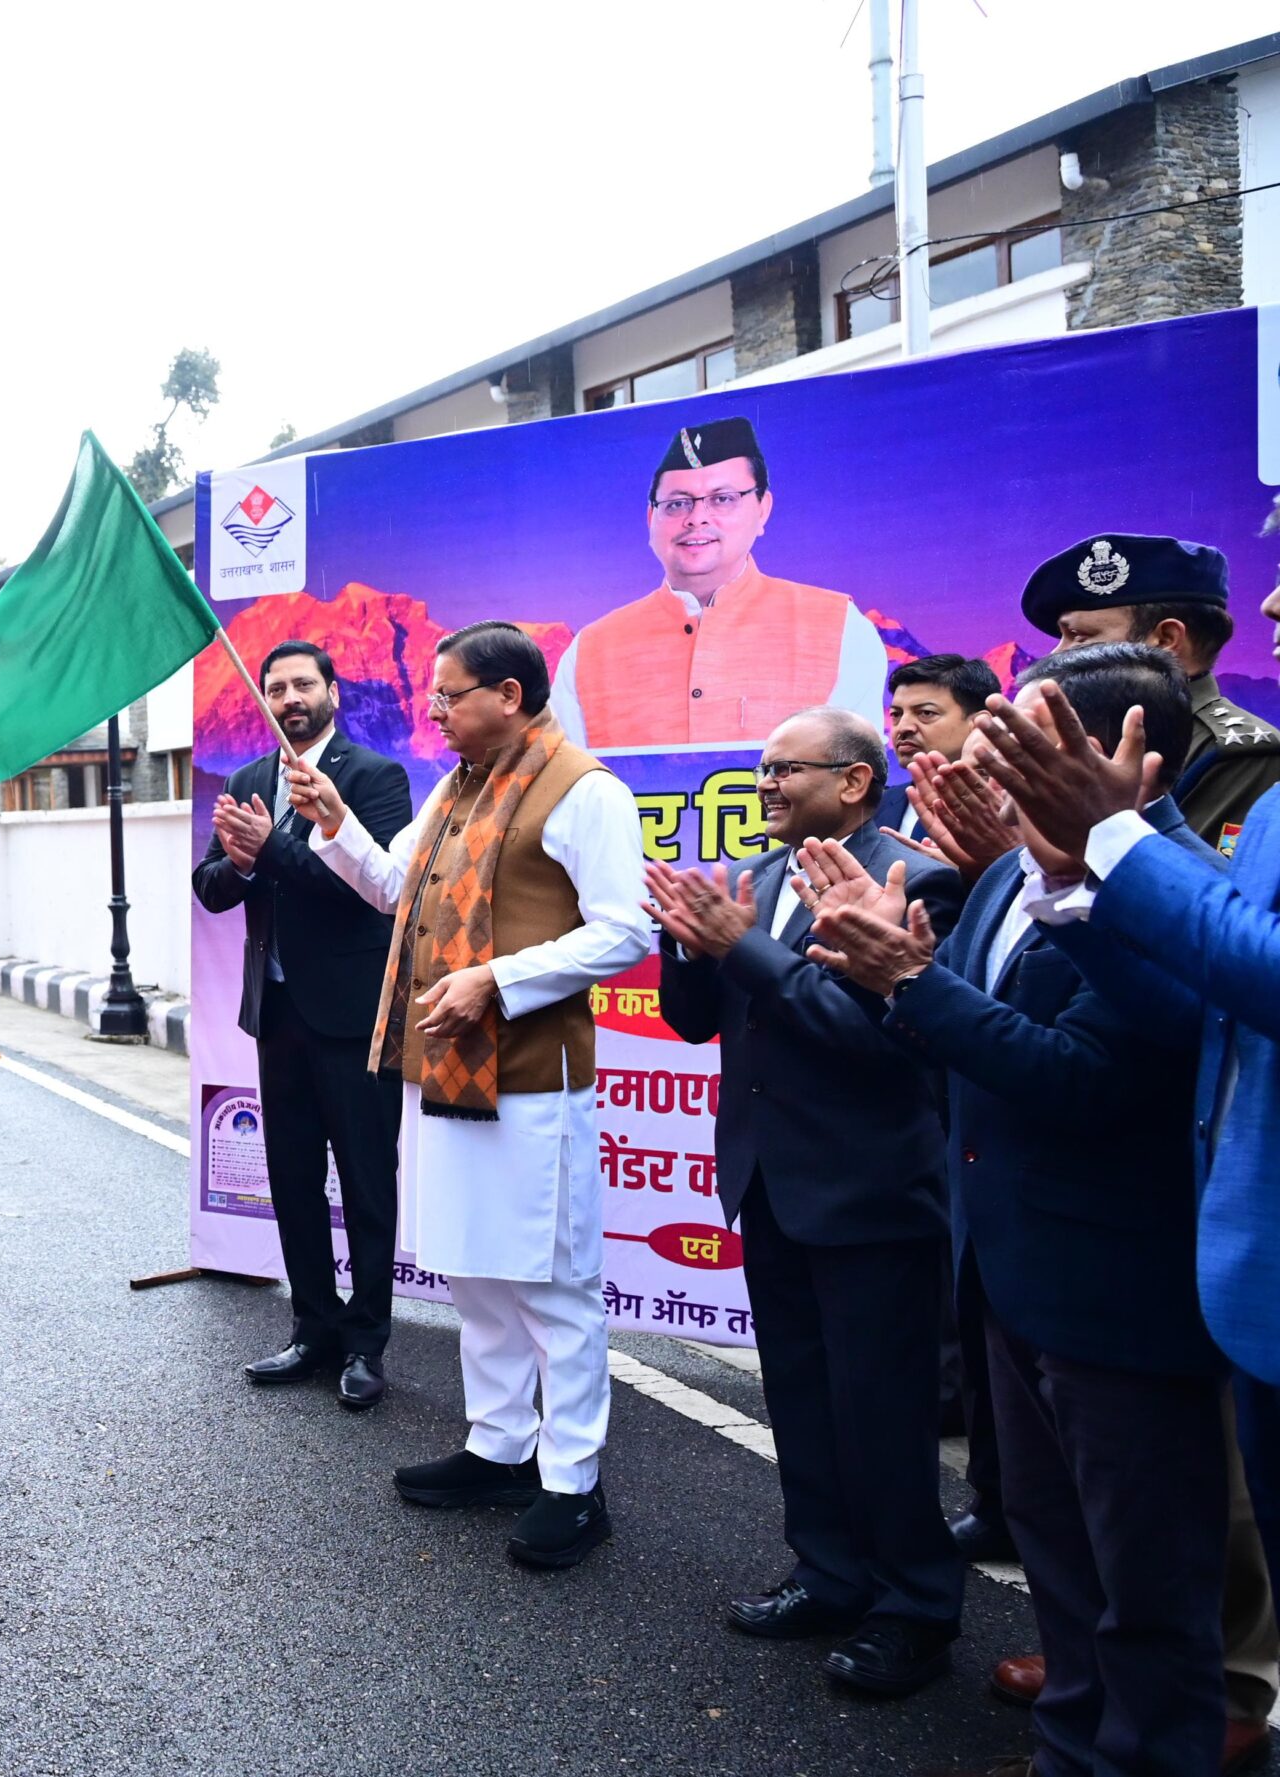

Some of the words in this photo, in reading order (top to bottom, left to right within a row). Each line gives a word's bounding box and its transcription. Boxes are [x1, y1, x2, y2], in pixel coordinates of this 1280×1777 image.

[220, 564, 264, 578] उत्तराखण्ड
[269, 560, 296, 573] शासन
[679, 1233, 721, 1263] एवं
[652, 1289, 719, 1329] ऑफ
